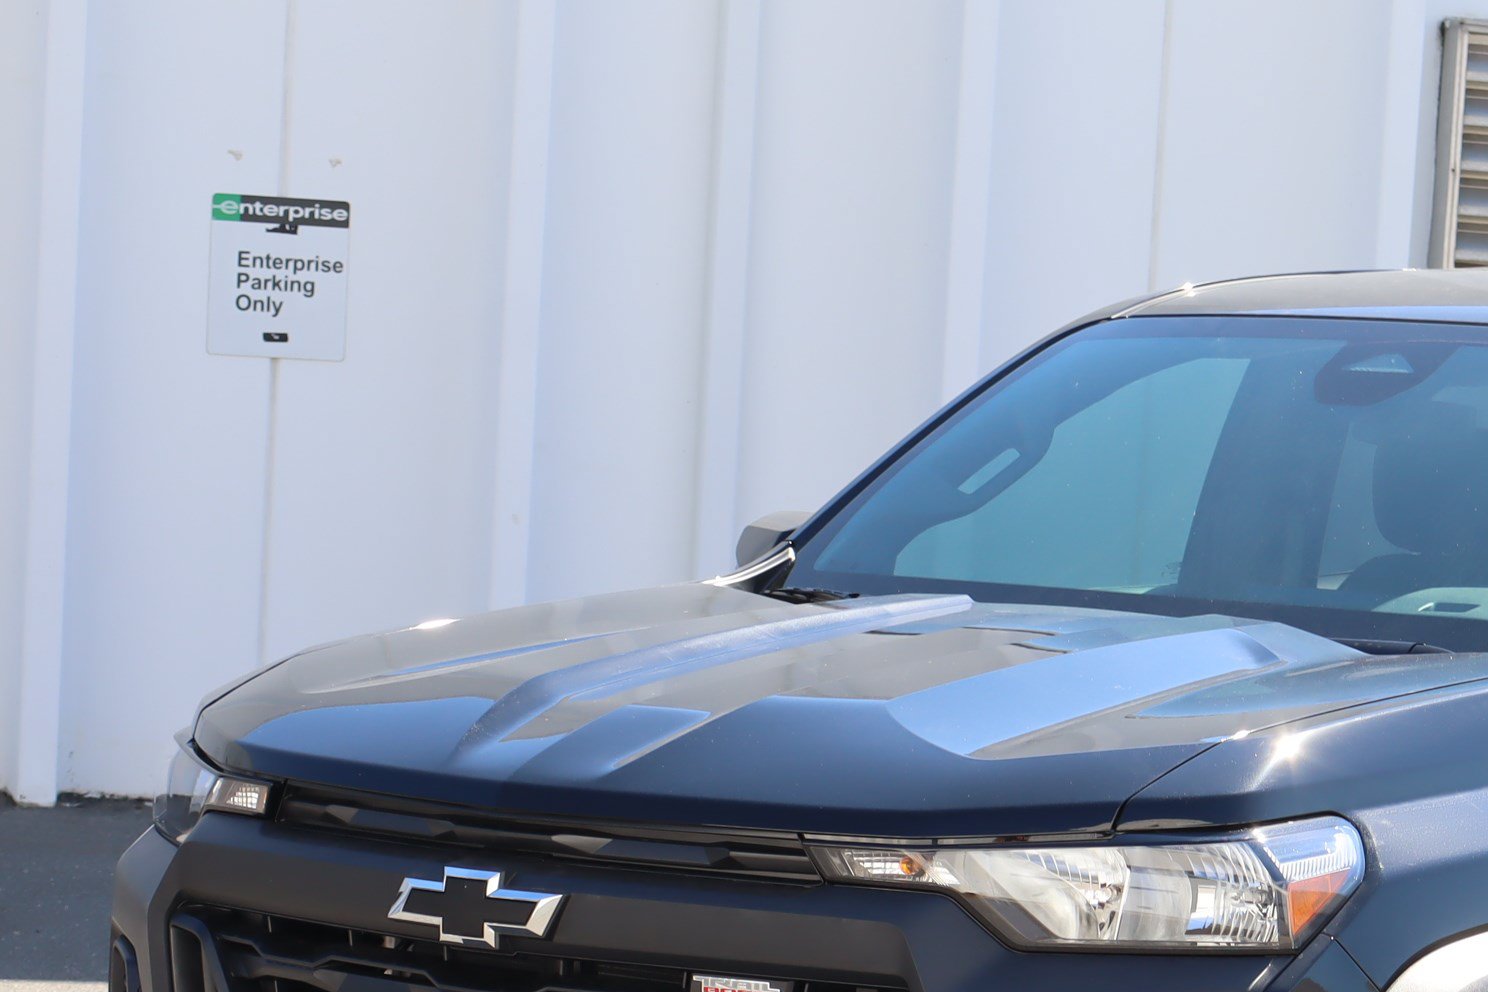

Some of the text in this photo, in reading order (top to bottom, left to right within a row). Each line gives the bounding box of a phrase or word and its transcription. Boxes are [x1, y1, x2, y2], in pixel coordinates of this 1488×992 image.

[217, 199, 348, 222] enterprise
[237, 250, 344, 275] Enterprise
[236, 272, 315, 298] Parking
[235, 294, 284, 318] Only
